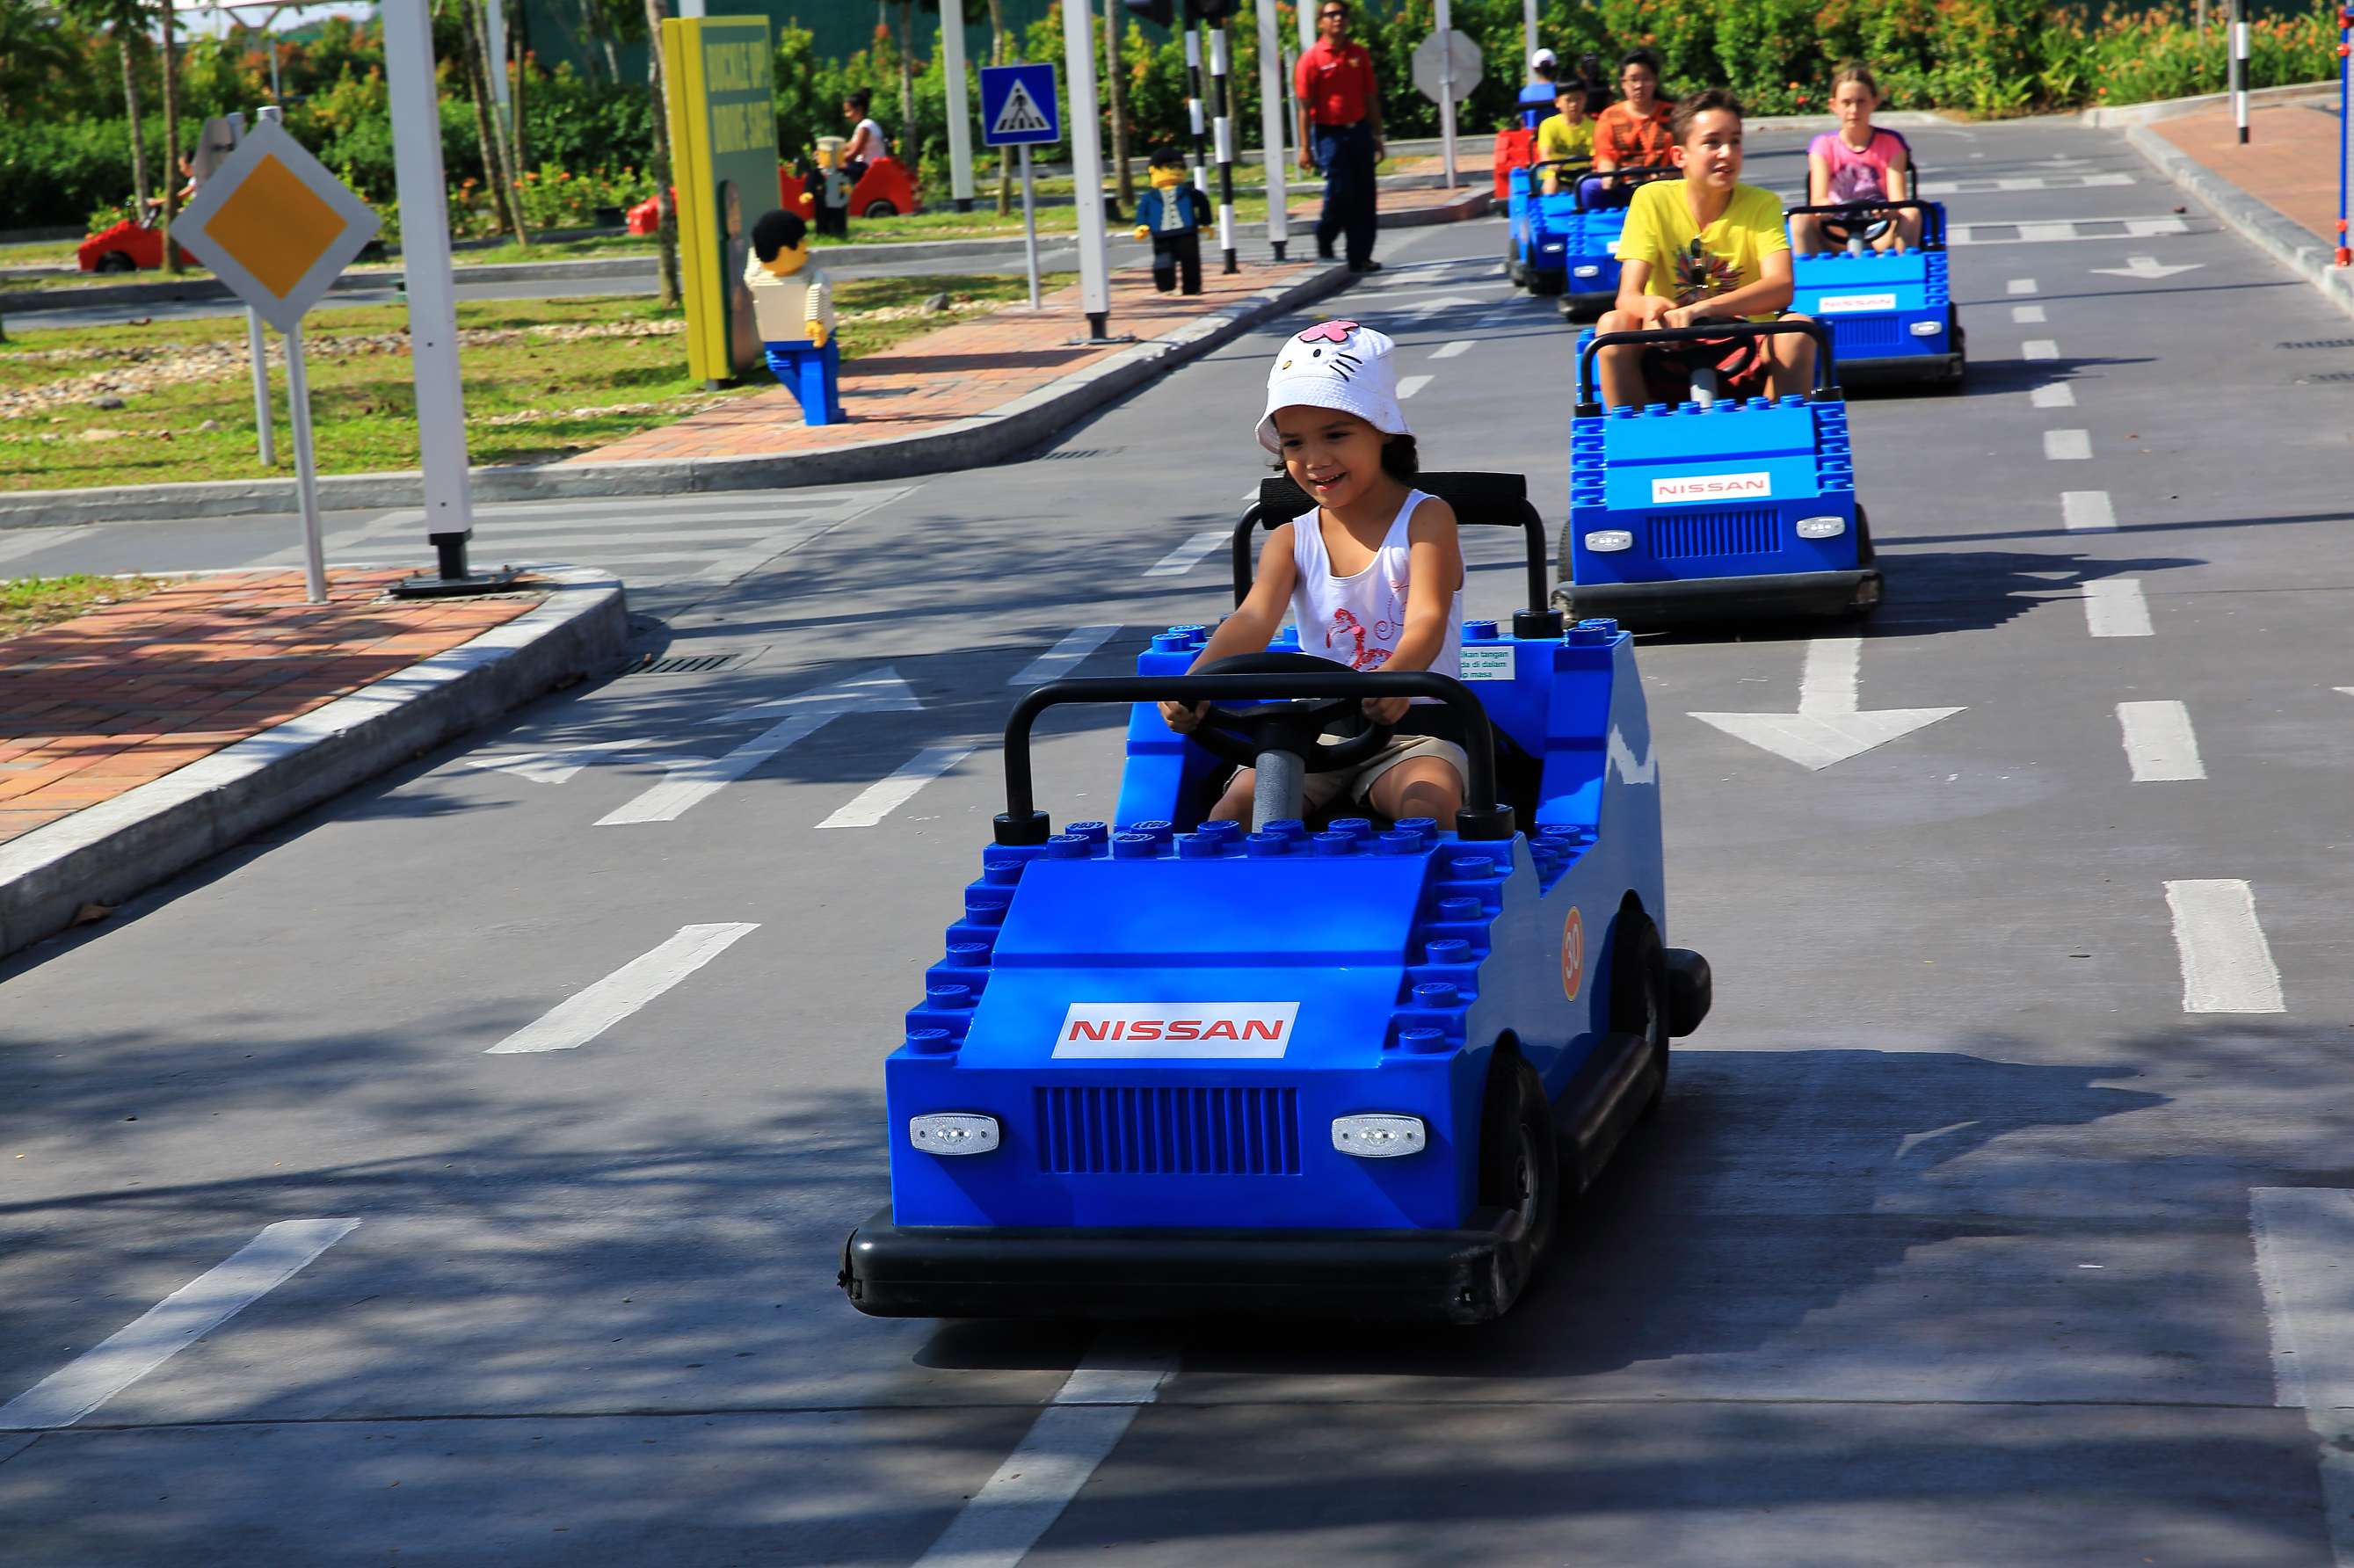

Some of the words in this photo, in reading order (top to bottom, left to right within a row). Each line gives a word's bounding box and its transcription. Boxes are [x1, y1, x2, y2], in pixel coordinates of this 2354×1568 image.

[1658, 480, 1764, 496] NISSAN
[1565, 923, 1580, 979] 30
[1068, 1020, 1284, 1041] NISSAN
